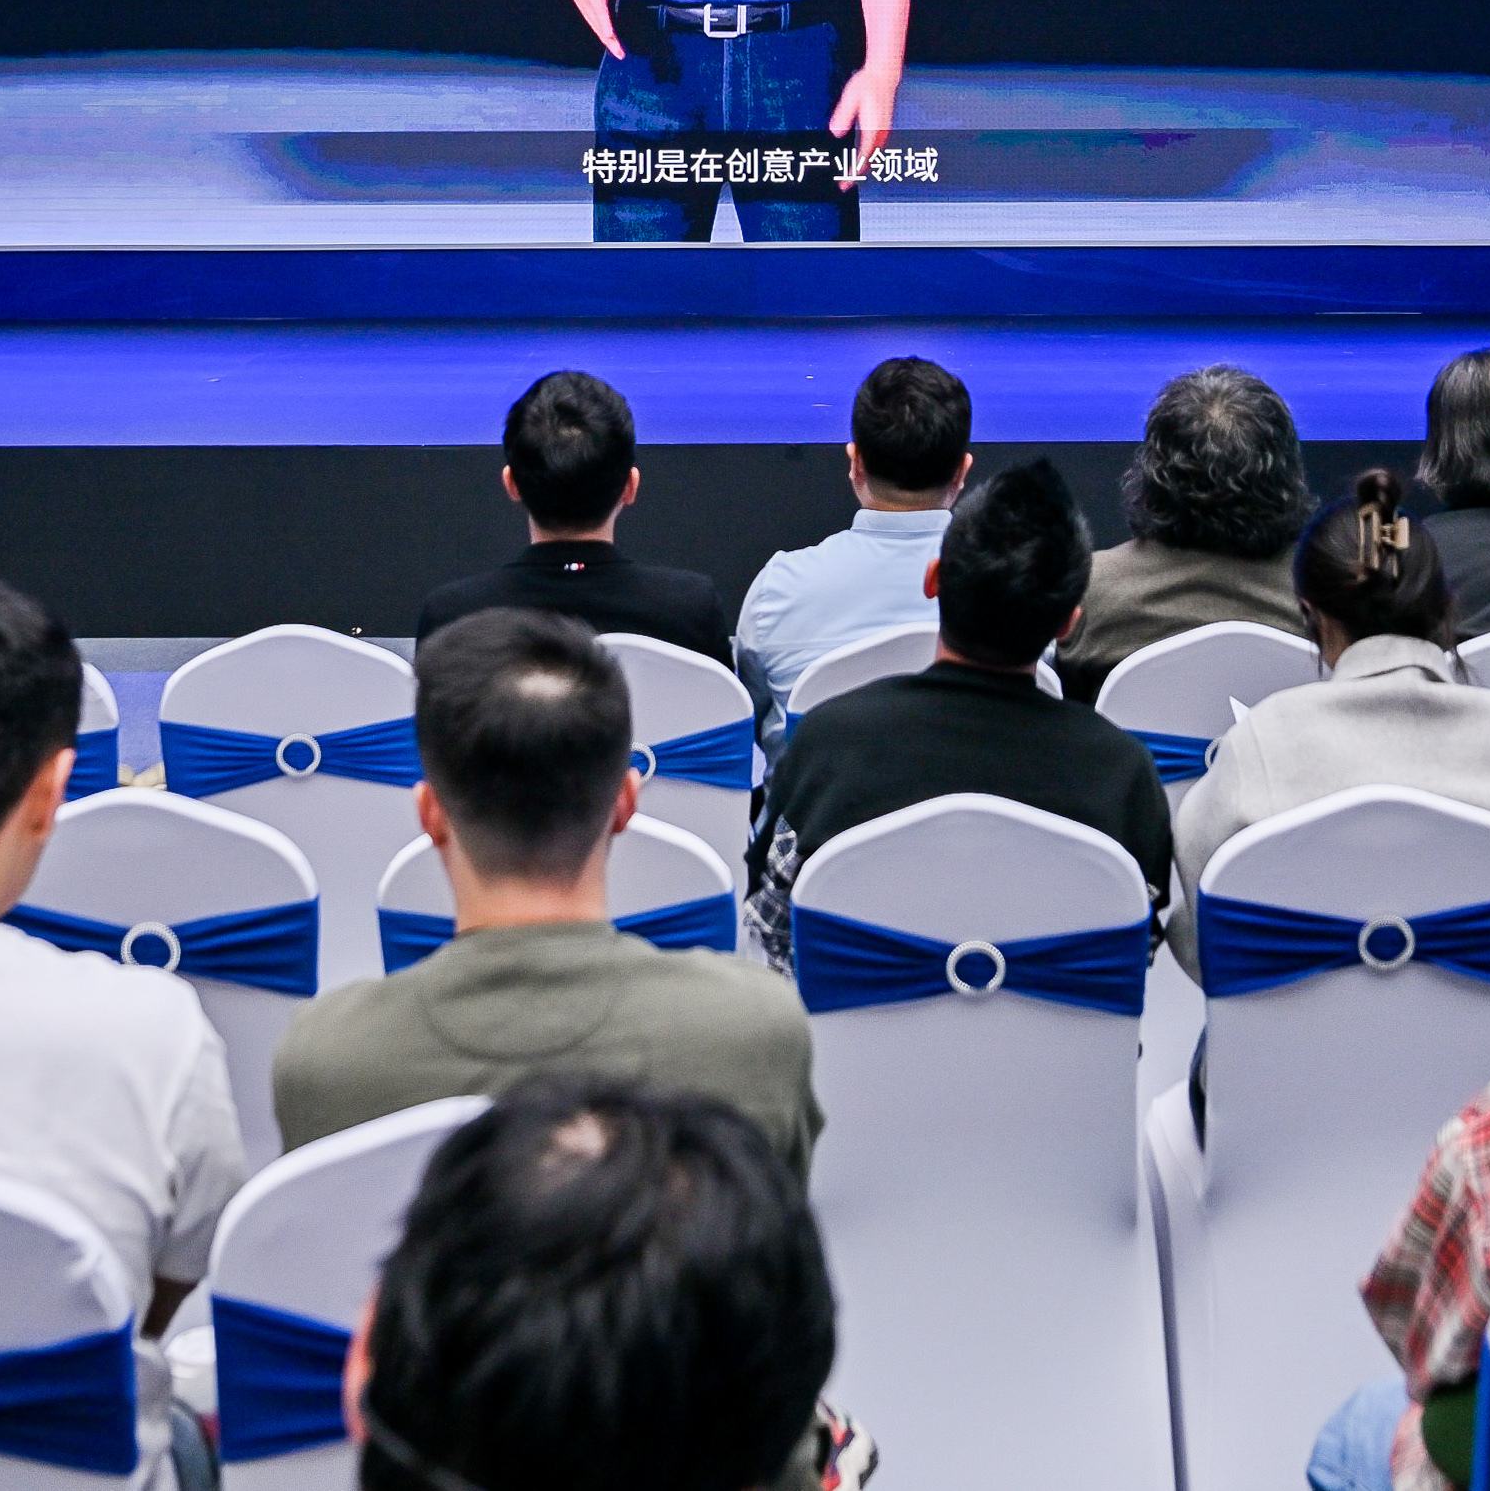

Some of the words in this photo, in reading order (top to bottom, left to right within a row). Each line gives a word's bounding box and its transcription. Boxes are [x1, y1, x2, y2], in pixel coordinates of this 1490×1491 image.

[582, 147, 940, 184] 特别是在创意产业领域
